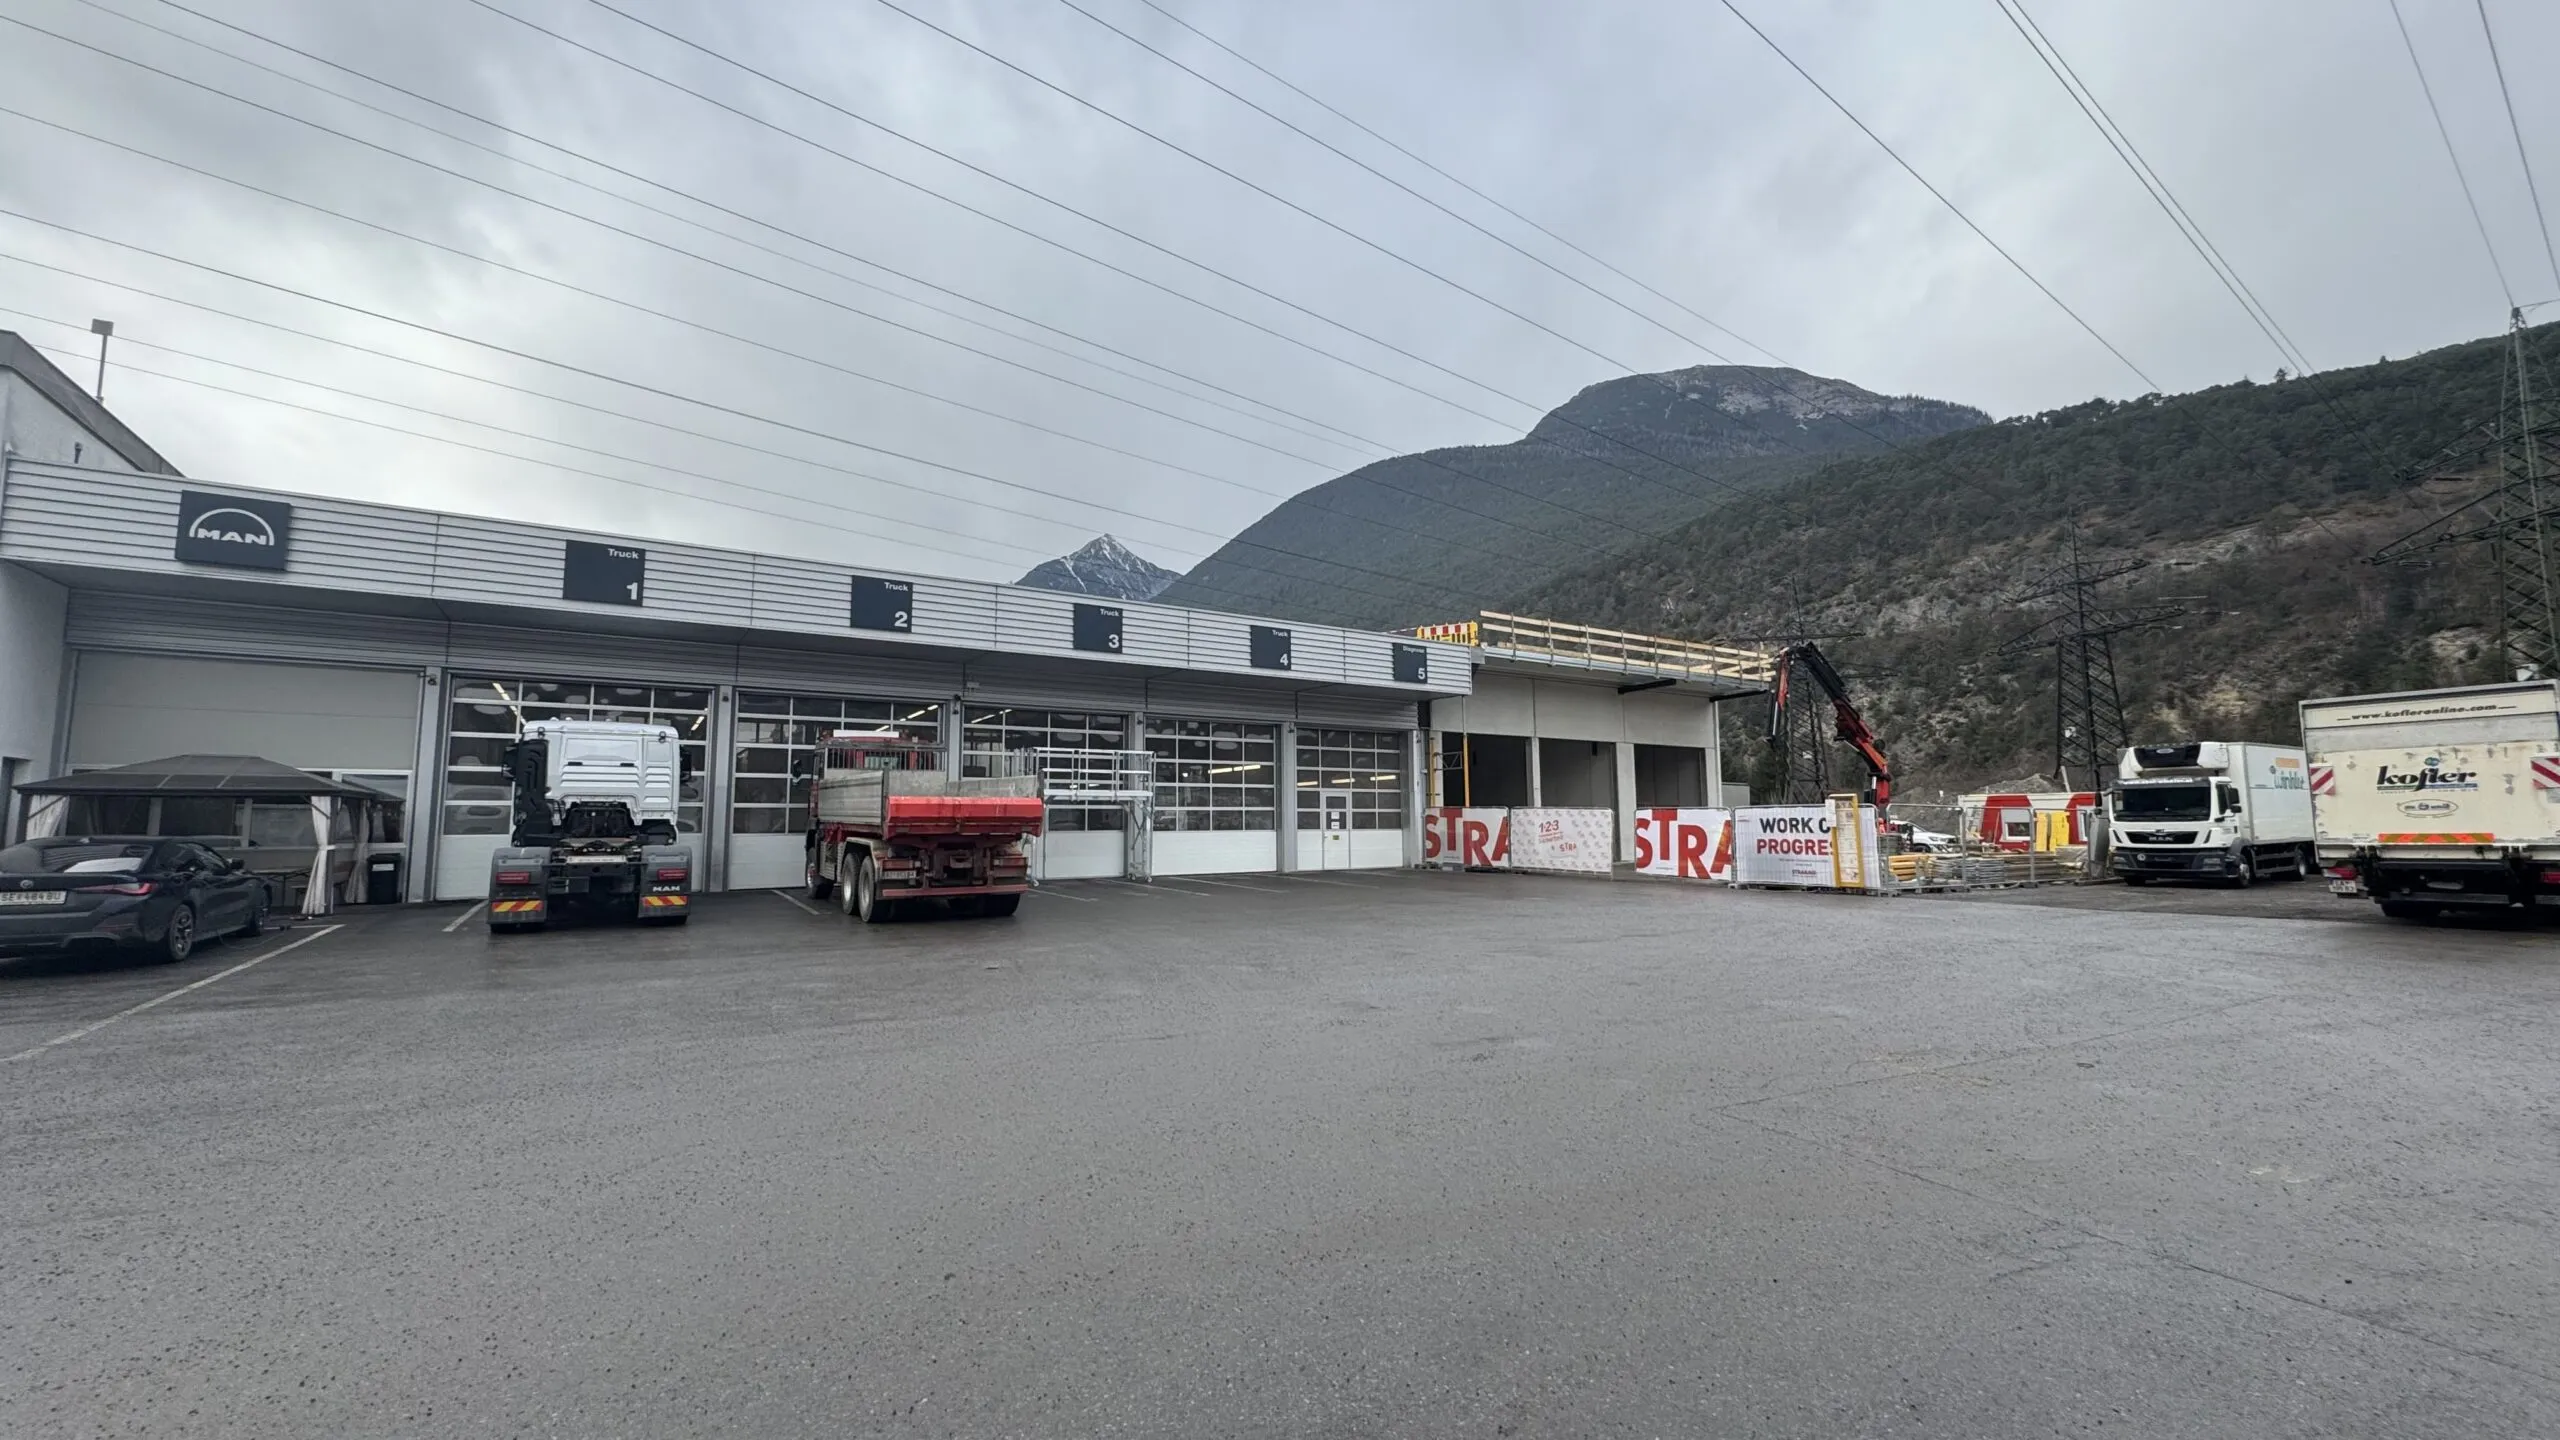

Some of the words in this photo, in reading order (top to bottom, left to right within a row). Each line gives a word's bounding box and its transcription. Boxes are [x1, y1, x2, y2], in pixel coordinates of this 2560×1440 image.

[196, 528, 267, 546] MAN
[607, 548, 640, 560] Truck
[626, 582, 639, 600] 1
[884, 581, 909, 592] Truck
[894, 610, 909, 628] 2
[1099, 608, 1120, 617] Truck
[1108, 634, 1120, 649] 3
[1279, 653, 1289, 667] 4
[1417, 667, 1426, 680] 5
[2351, 704, 2498, 721] www.kofleronline.com
[2377, 765, 2478, 792] kofler
[1760, 817, 1814, 834] WORK
[1756, 838, 1833, 856] PROGRE
